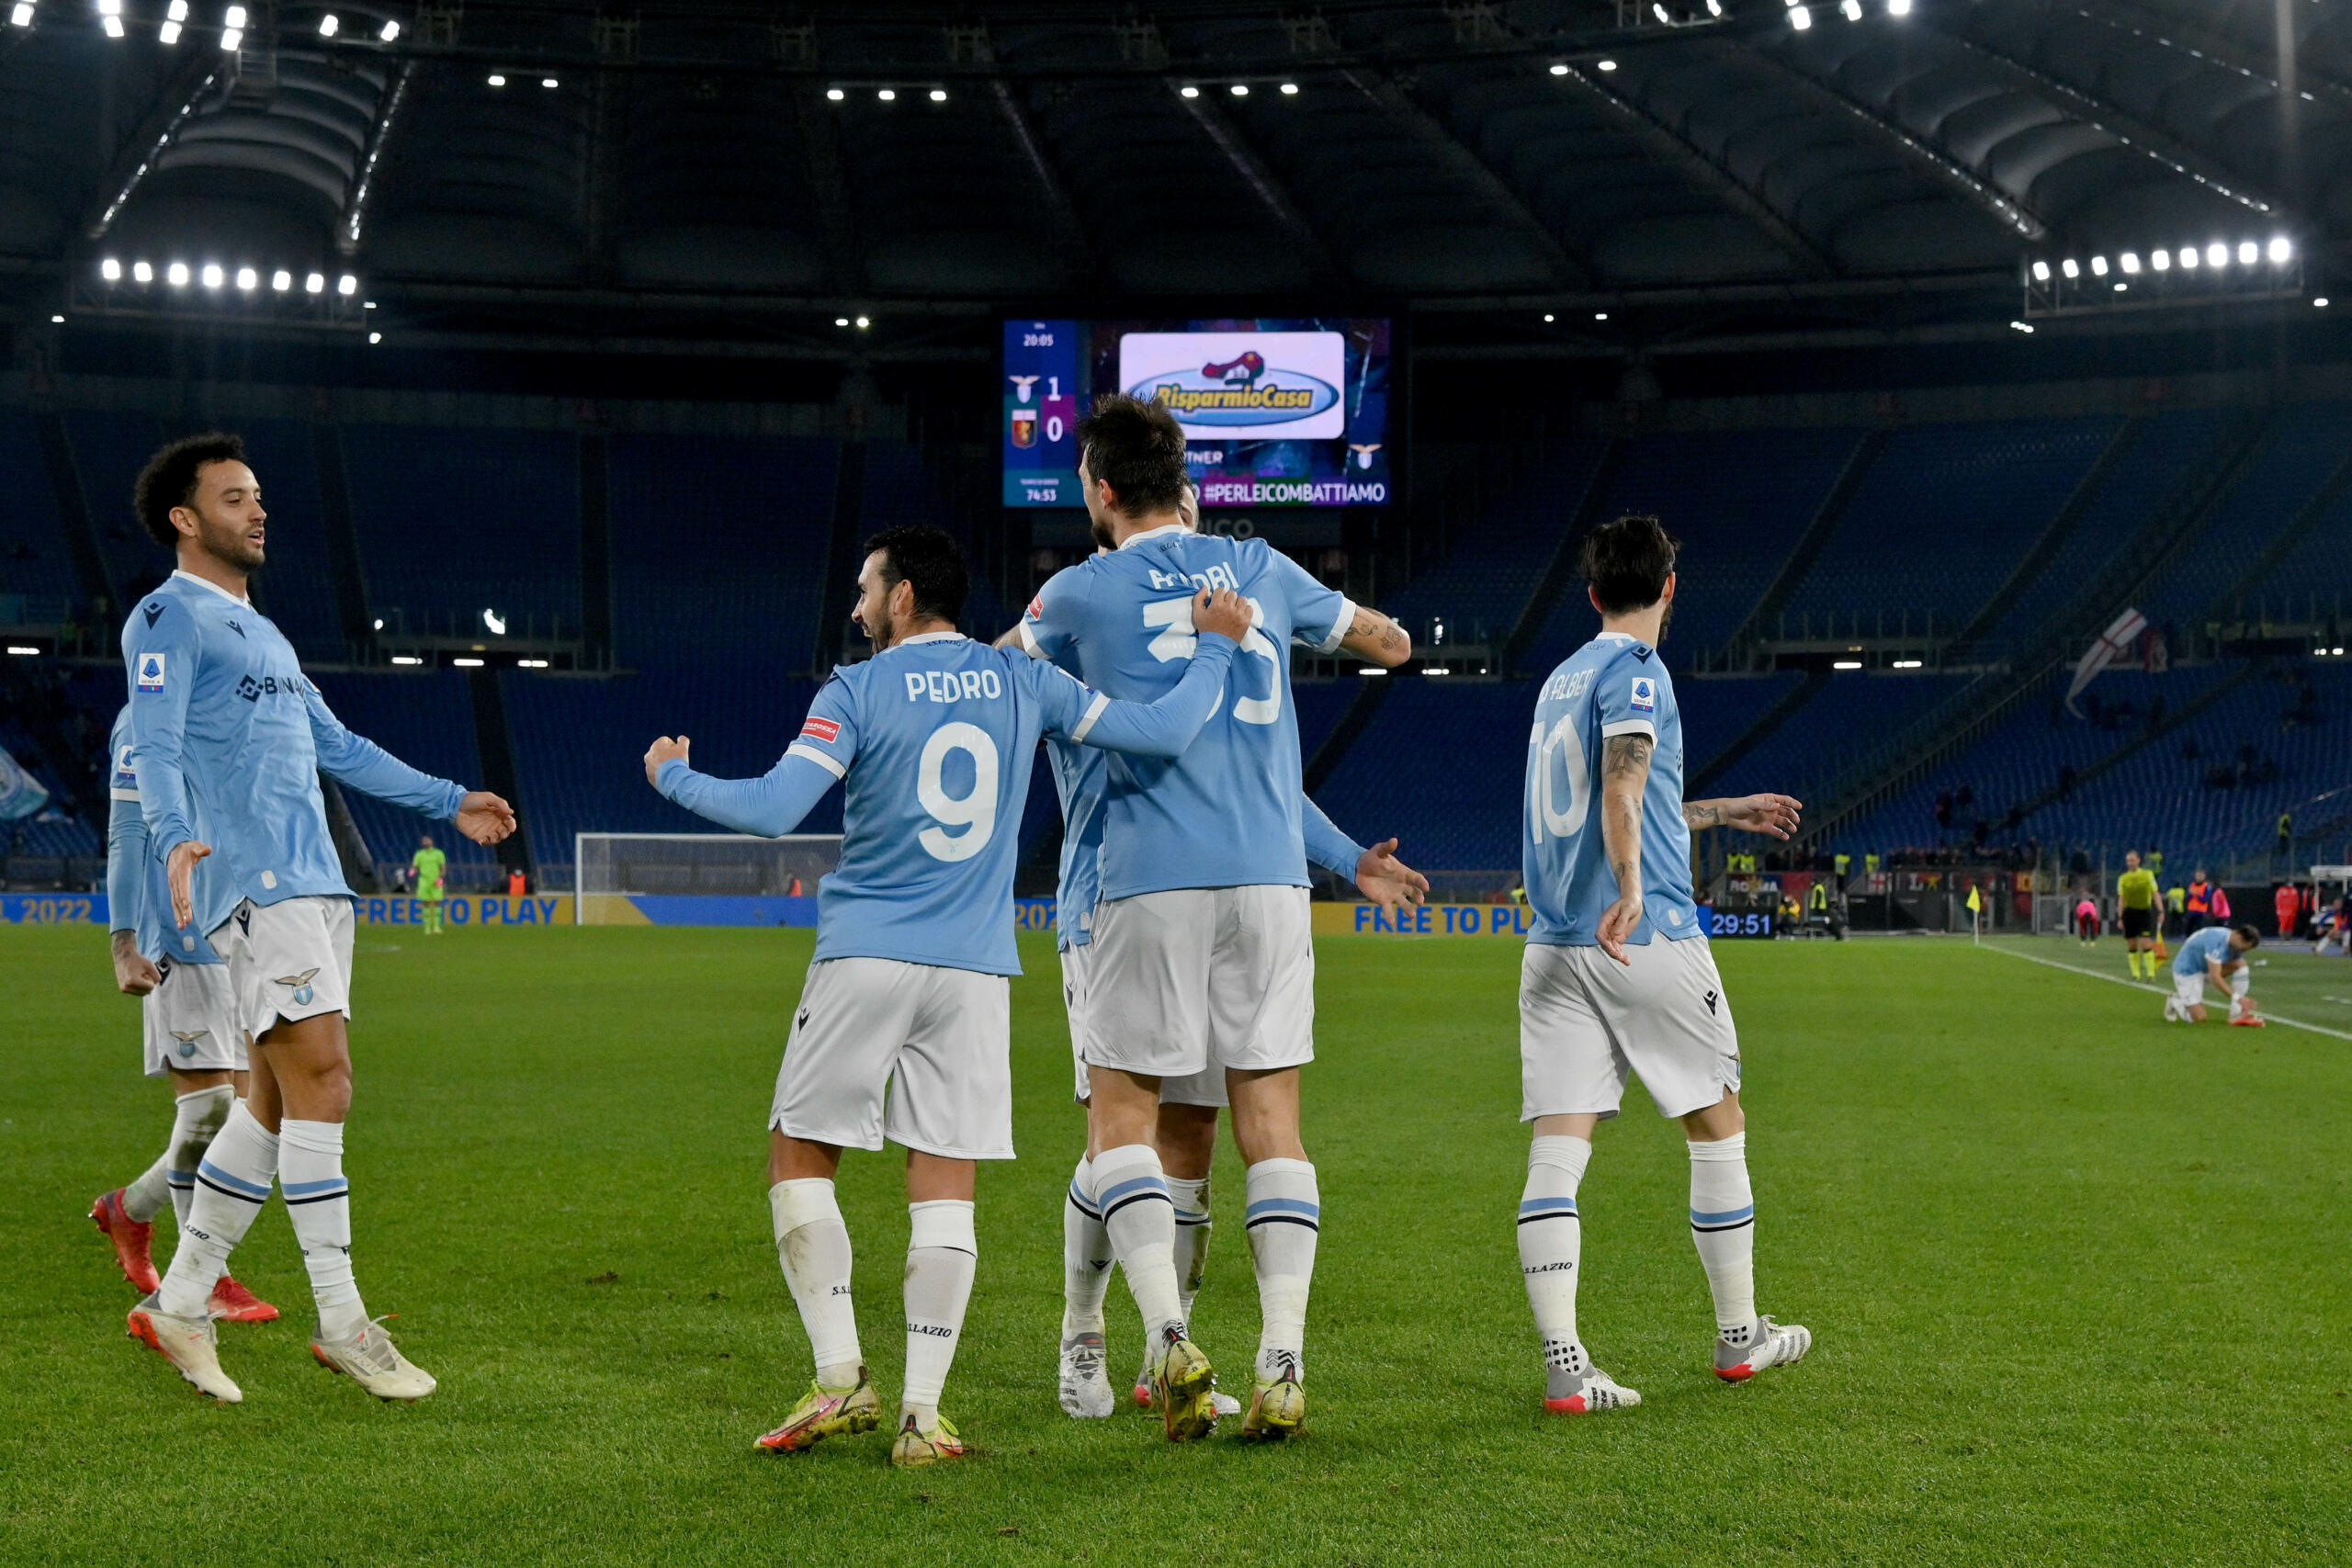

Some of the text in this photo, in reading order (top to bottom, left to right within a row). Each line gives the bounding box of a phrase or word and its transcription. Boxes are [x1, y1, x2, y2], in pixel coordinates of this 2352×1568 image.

[1023, 333, 1055, 347] 20:05
[1048, 376, 1062, 401] 1
[1157, 384, 1312, 412] RisparmioCasa
[1046, 415, 1063, 442] 0
[1183, 450, 1224, 465] TNER
[1204, 482, 1385, 503] #PERLEICOMBATTIAMO
[904, 669, 1001, 704] PEDRO
[916, 721, 1000, 863] 9
[1530, 714, 1591, 845] 10
[21, 898, 92, 925] 2022
[355, 898, 424, 926] FREE
[481, 898, 559, 926] PLAY
[1354, 906, 1433, 933] FREE
[1442, 907, 1481, 934] TO
[1712, 913, 1770, 935] 29:51
